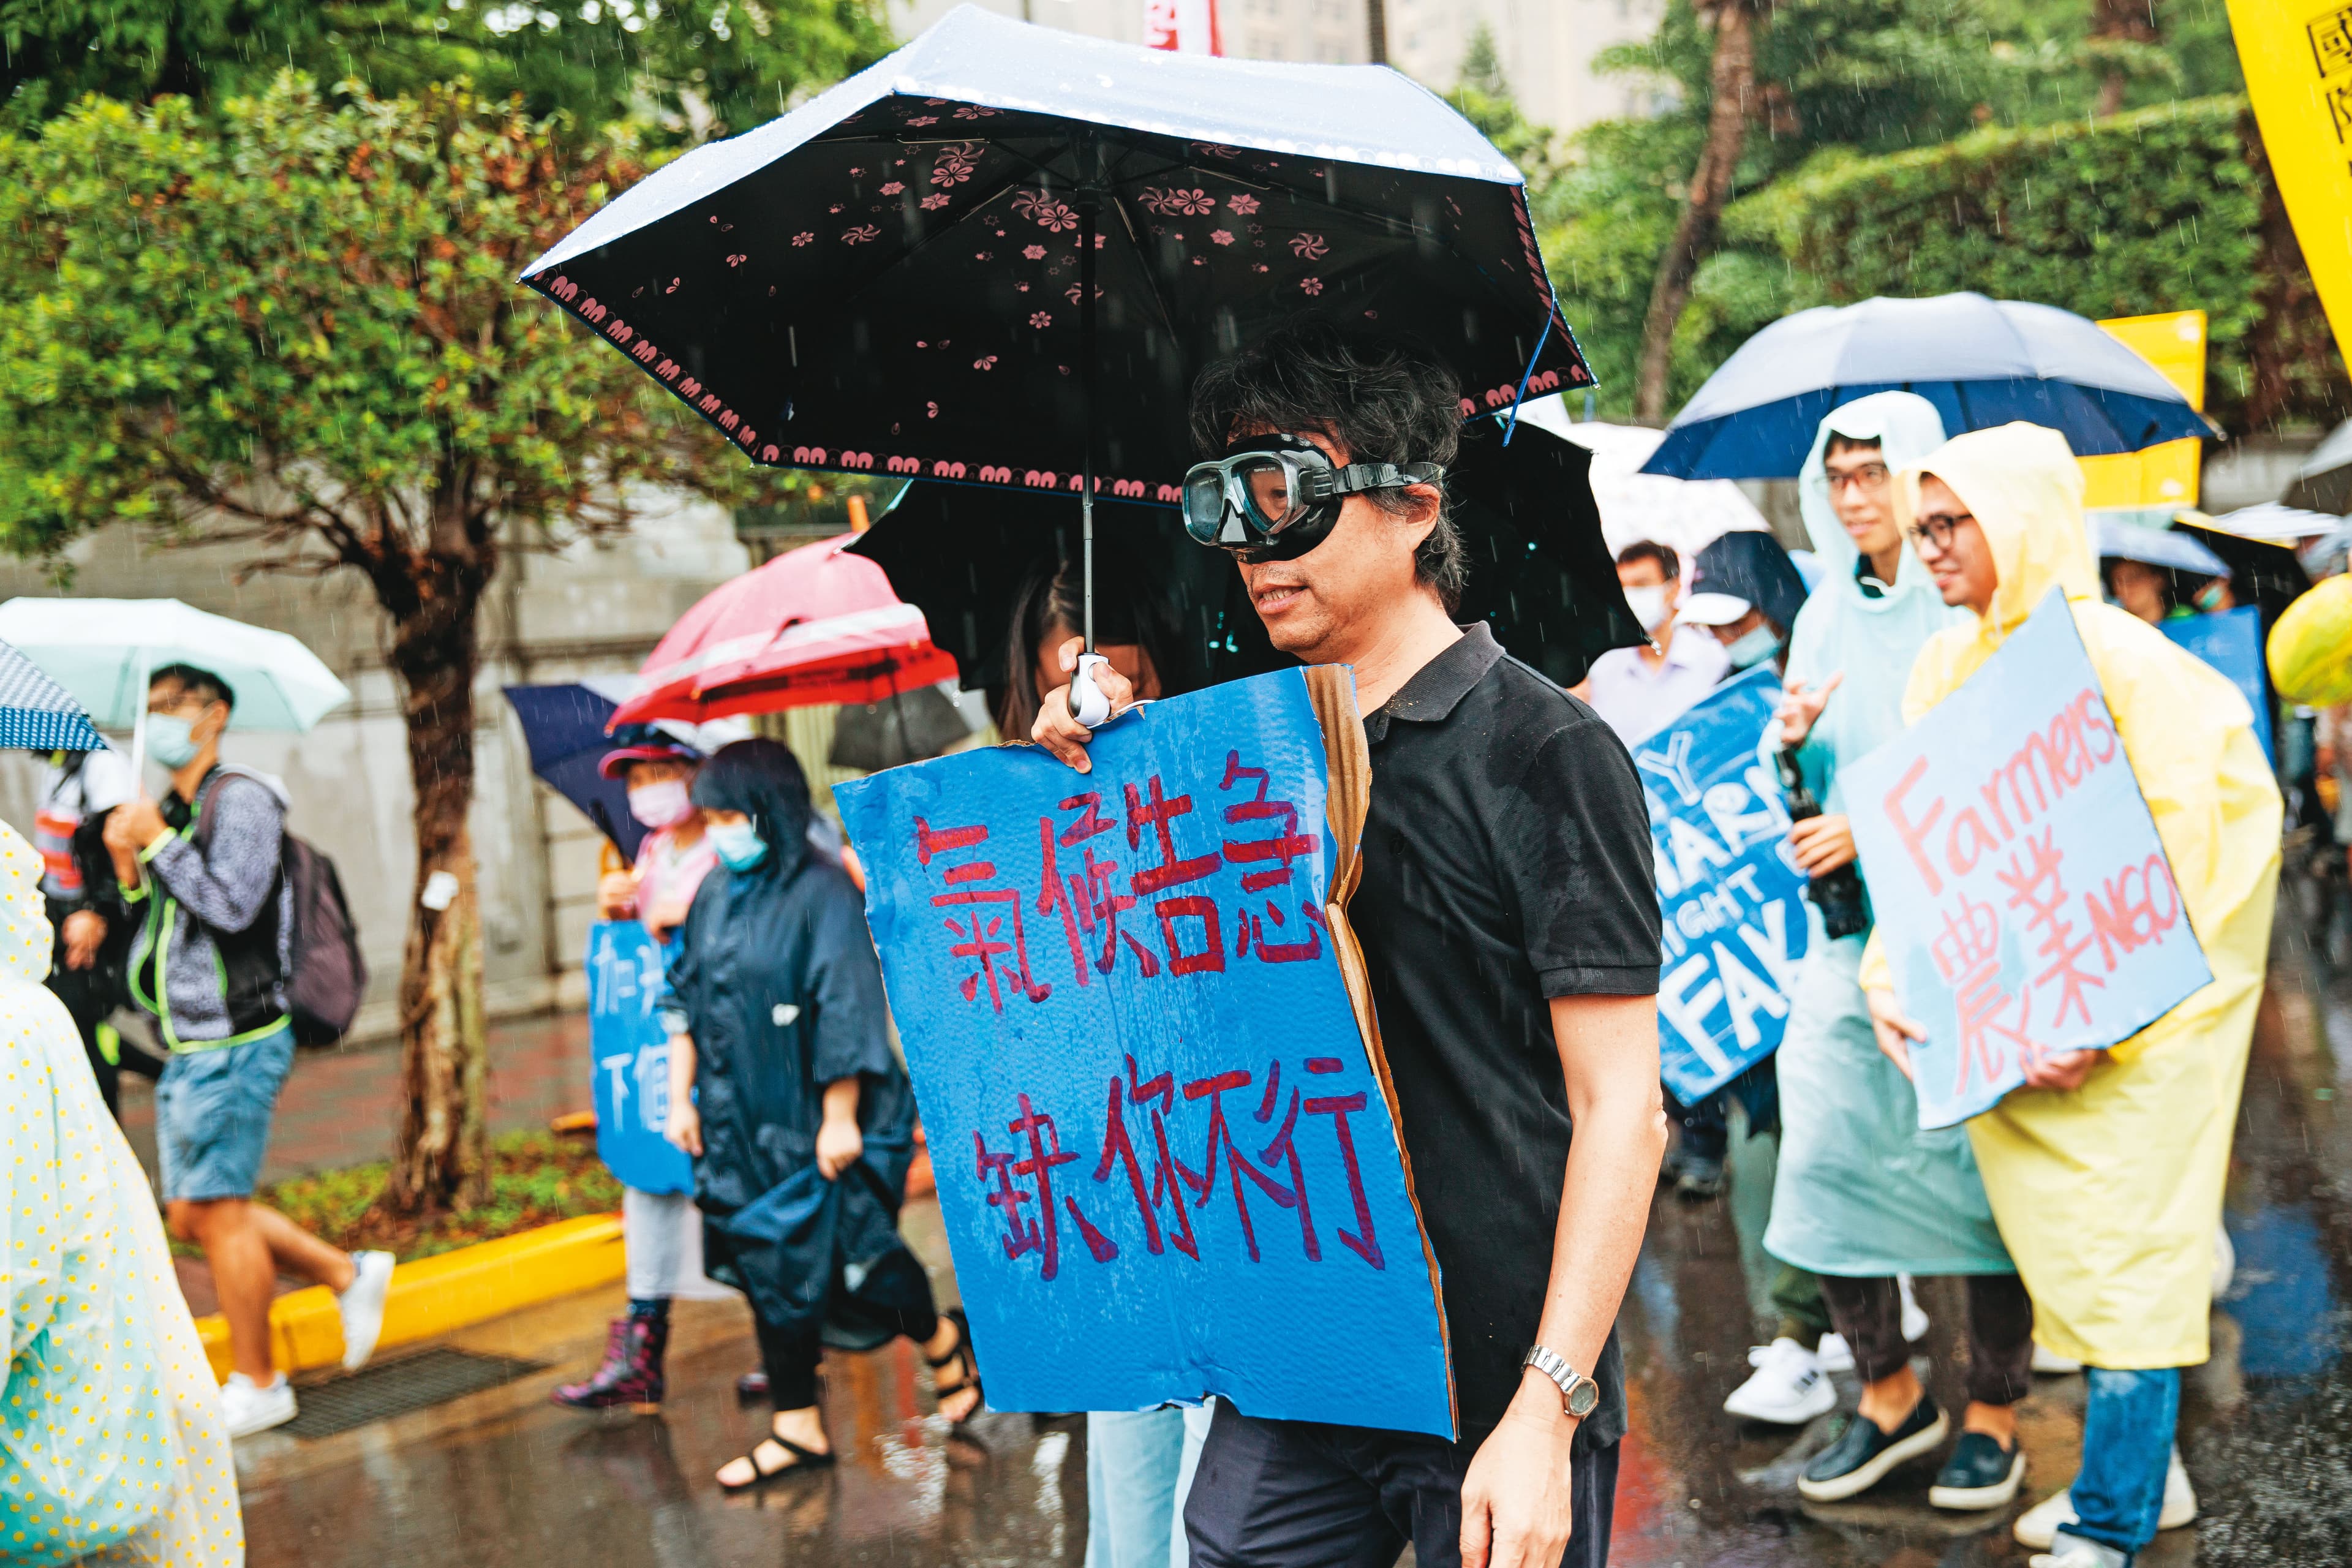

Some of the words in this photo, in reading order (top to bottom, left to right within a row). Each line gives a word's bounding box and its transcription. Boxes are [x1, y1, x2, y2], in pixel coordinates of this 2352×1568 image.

[912, 749, 1327, 1014] 氣候告急
[1884, 688, 2116, 897] Farmers
[1660, 850, 1765, 966] IGHT
[973, 1053, 1385, 1282] 缺你不行
